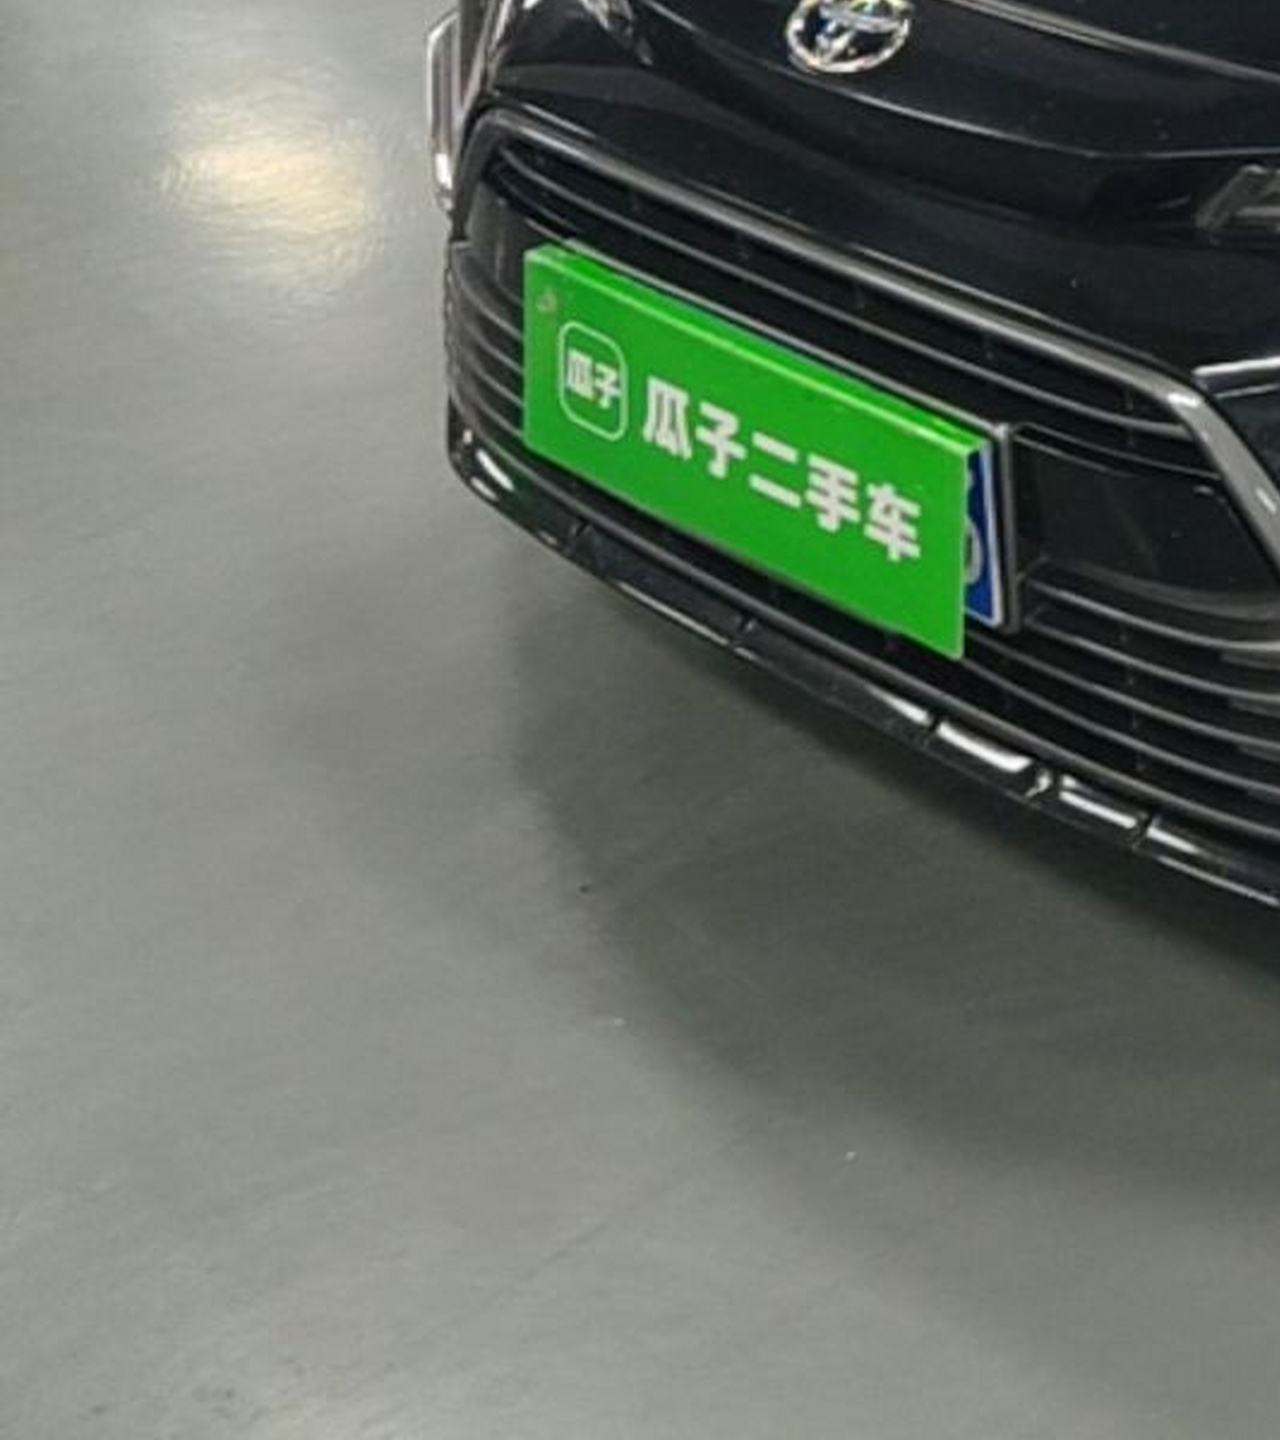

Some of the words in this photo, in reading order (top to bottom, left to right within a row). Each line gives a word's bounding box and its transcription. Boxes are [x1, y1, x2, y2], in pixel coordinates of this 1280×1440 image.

[566, 348, 620, 408] 瓜子
[644, 376, 921, 561] 瓜子二手车
